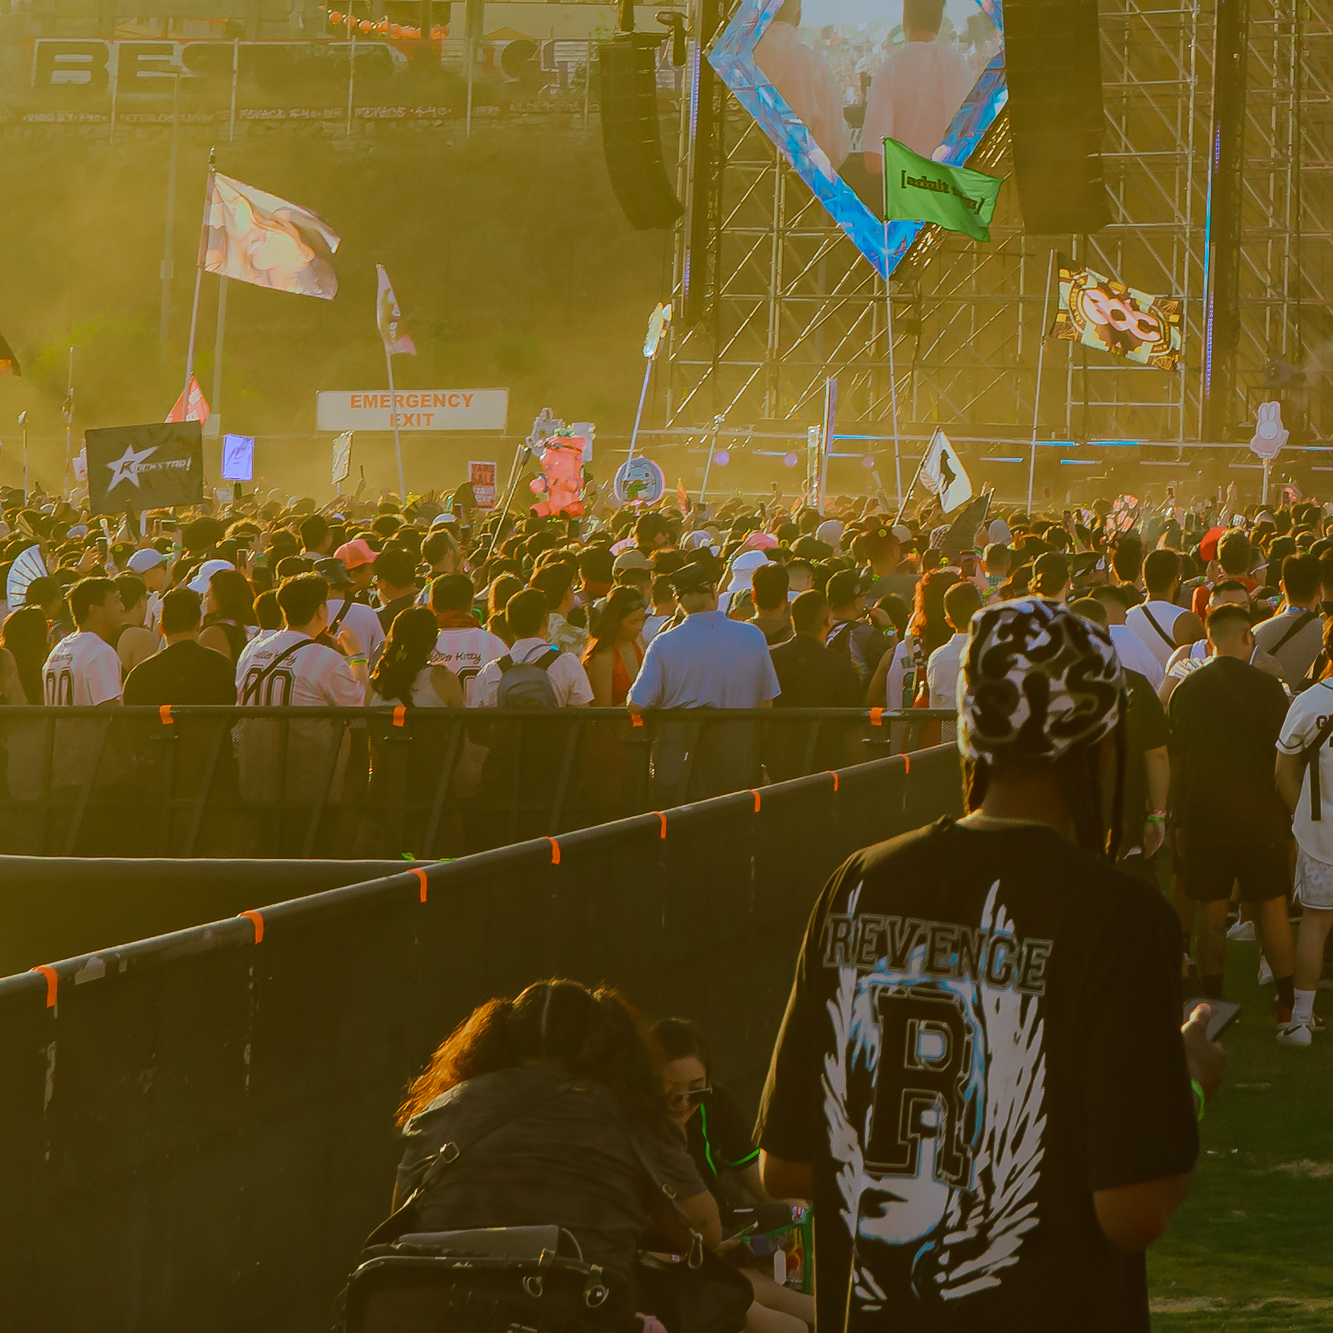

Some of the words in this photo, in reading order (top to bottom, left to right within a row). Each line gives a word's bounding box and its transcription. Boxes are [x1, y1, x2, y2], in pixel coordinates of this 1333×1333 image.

[349, 393, 476, 410] EMERGENCY
[389, 412, 435, 428] EXIT
[455, 652, 482, 665] Kitty
[823, 913, 1054, 997] REVENGE
